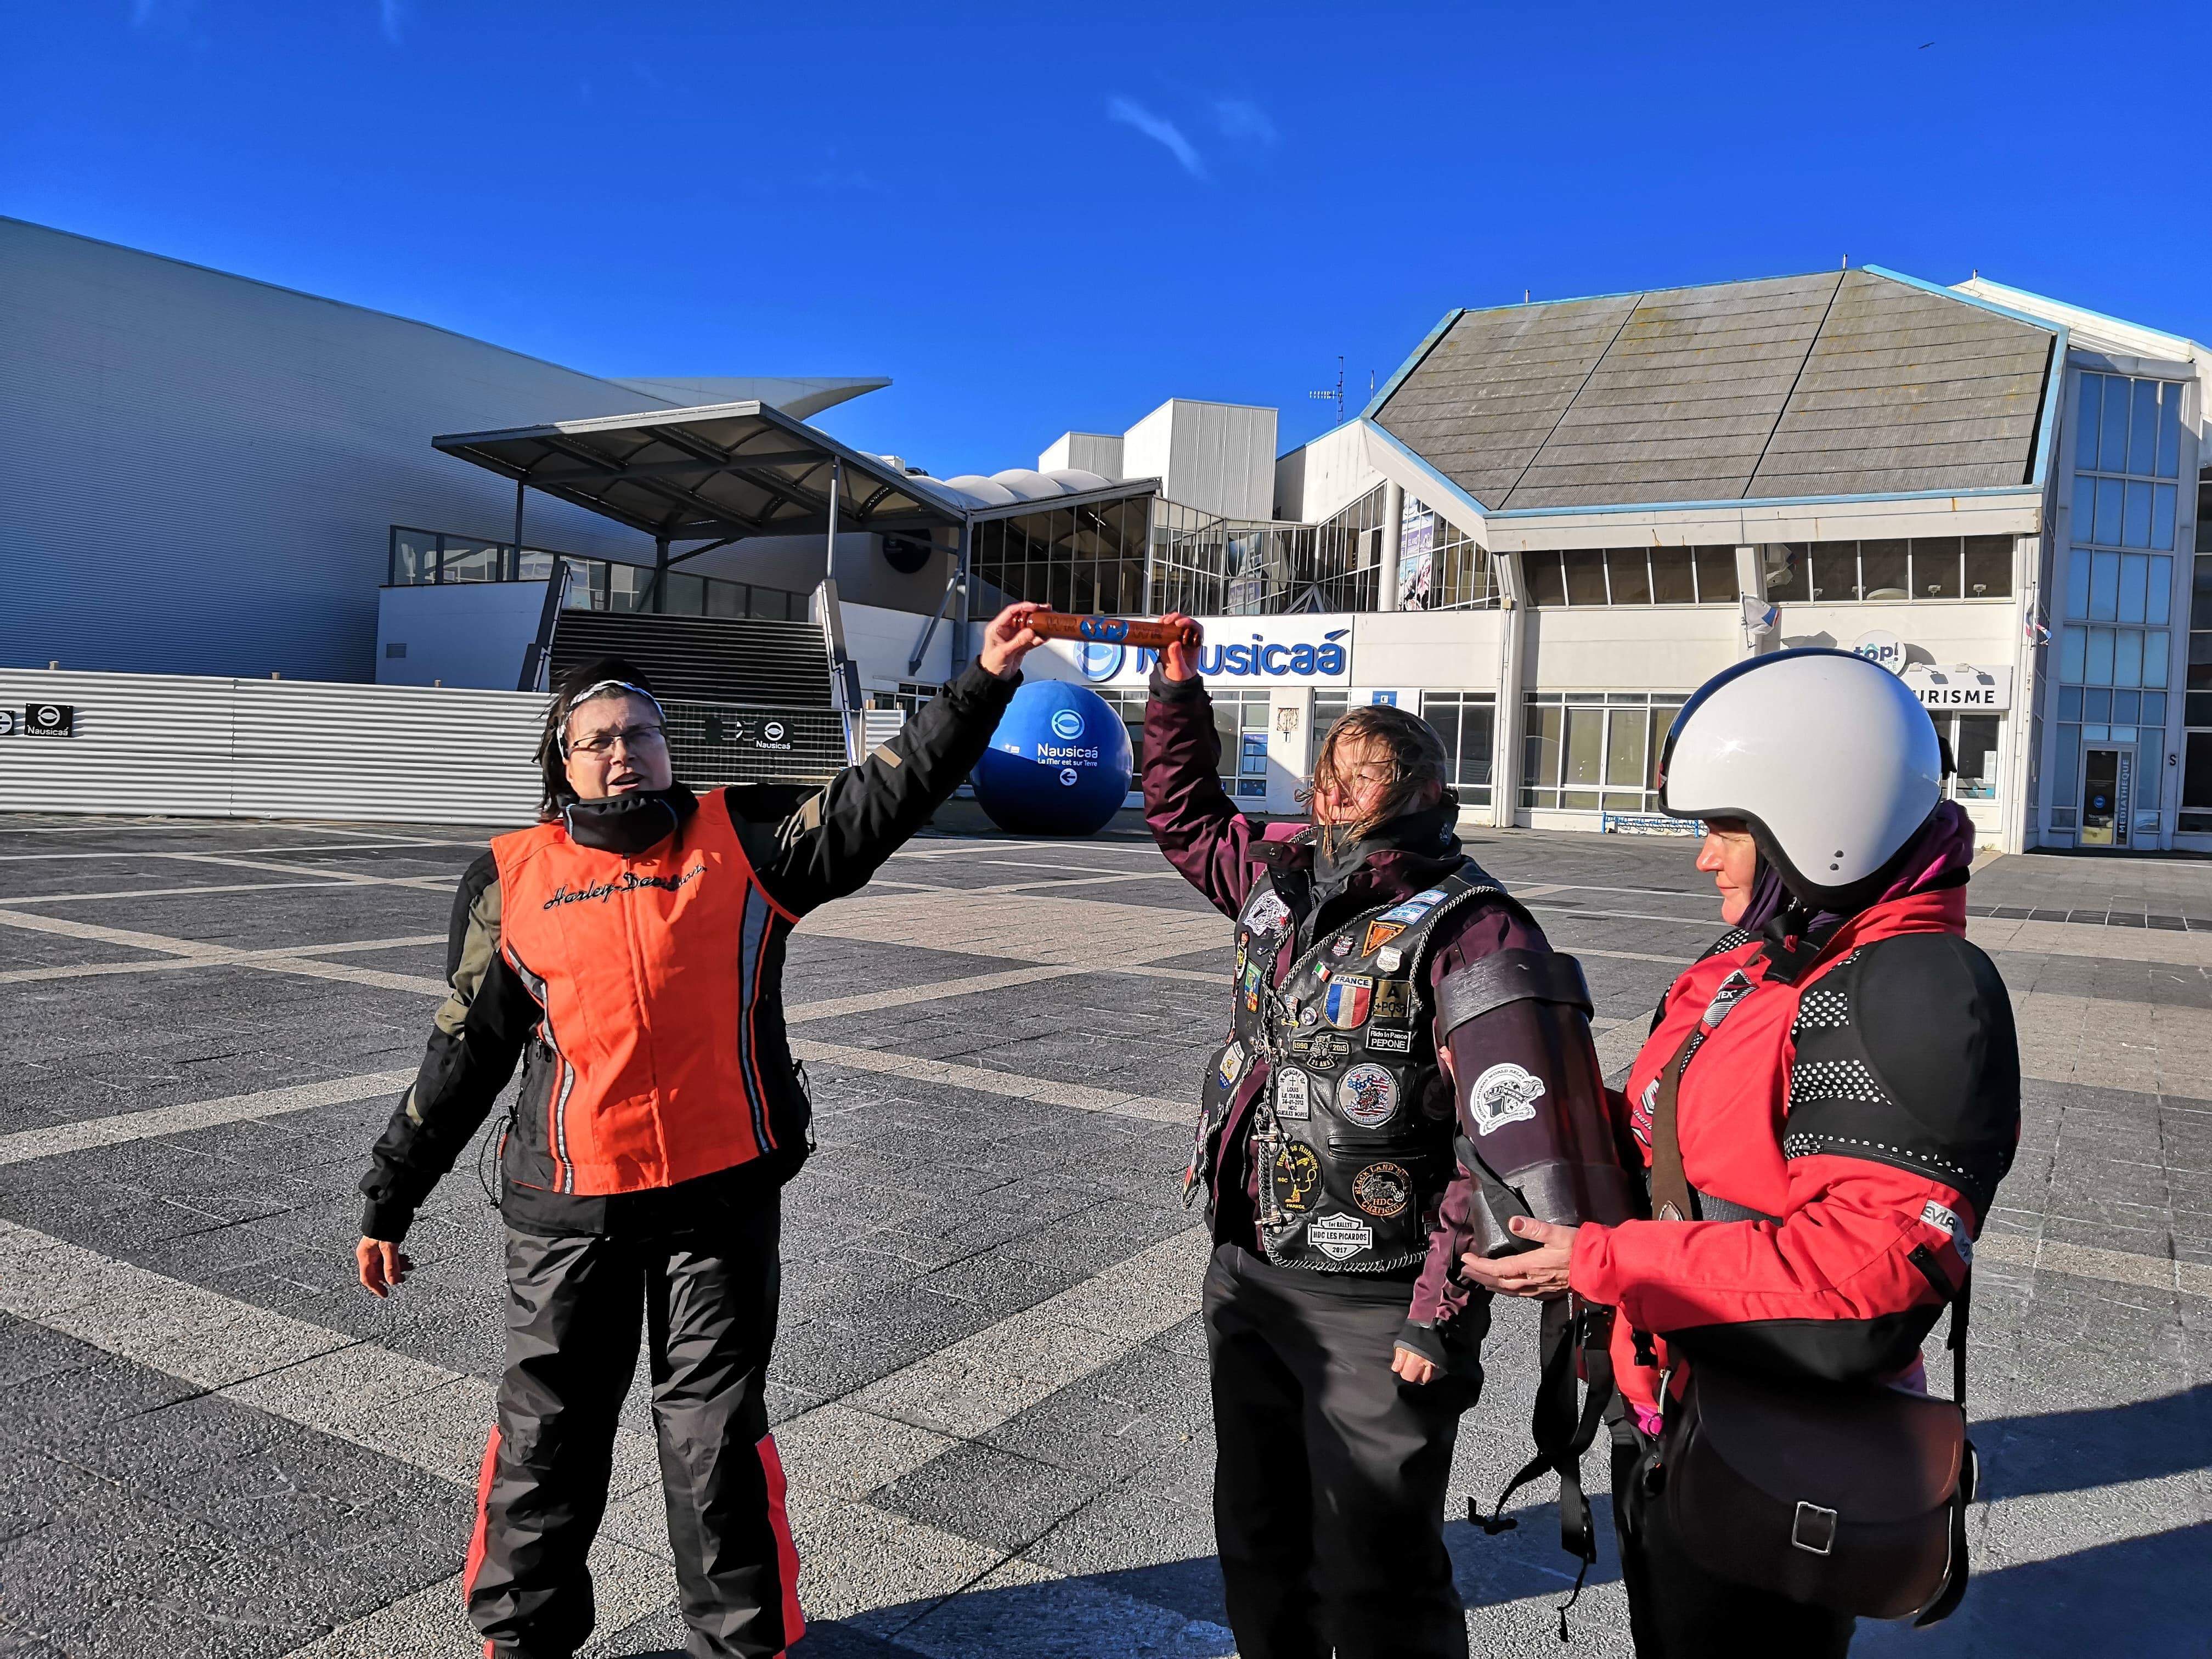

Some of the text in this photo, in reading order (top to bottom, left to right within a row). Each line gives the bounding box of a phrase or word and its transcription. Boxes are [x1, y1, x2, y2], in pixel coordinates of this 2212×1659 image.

[27, 725, 69, 736] Nausicaá
[756, 740, 791, 750] Nausicaá
[1037, 742, 1098, 759] Nausicaá
[2169, 754, 2177, 766] S
[2119, 759, 2130, 833] MEDIATHEQUE
[1335, 976, 1370, 986] FRANCE
[1371, 1038, 1406, 1049] PEPONE
[1282, 1069, 1302, 1078] MEMORY
[1488, 1069, 1509, 1079] WORLD
[1509, 1069, 1526, 1080] RELAY
[1477, 1079, 1488, 1099] RIDERS
[1476, 1101, 1487, 1119] WOMEN
[1299, 1144, 1318, 1170] Runners
[1355, 1164, 1394, 1195] BLACK LAND
[1313, 1231, 1367, 1241] HDC LES PICARDOS
